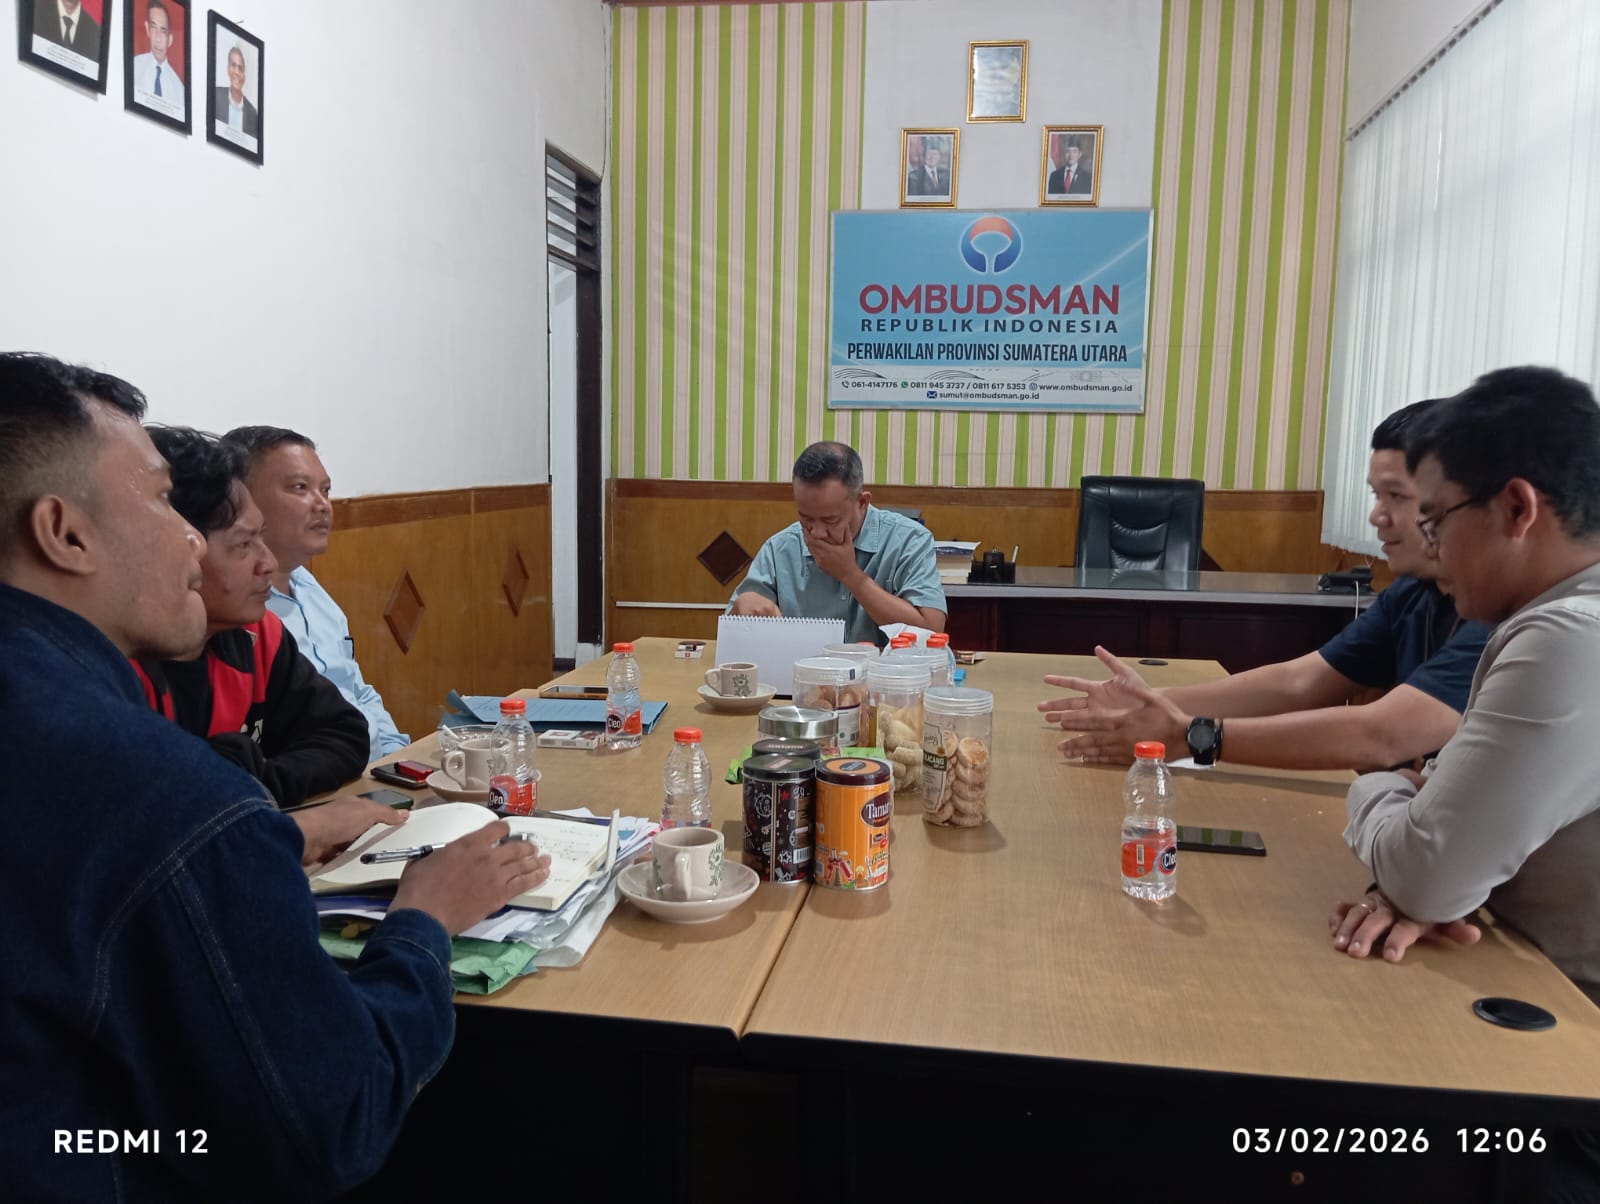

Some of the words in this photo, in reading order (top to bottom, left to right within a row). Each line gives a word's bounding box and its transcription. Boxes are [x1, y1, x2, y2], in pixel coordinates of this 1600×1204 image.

[859, 284, 1120, 315] OMBUDSMAN
[861, 318, 973, 333] REPUBLIK
[984, 319, 1118, 334] INDONESIA
[847, 342, 934, 360] PERWAKILAN
[937, 343, 1000, 361] PROVINSI
[1003, 343, 1078, 362] SUMATERA
[1081, 344, 1128, 363] UTARA
[851, 381, 898, 389] 061-4147176
[910, 381, 928, 389] 0811
[929, 381, 945, 389] 945
[946, 382, 965, 390] 3737
[972, 382, 990, 390] 0811
[991, 382, 1004, 390] 617
[1006, 383, 1026, 391] 5353
[1039, 383, 1133, 393] www.ombudsman.go.id
[939, 390, 1040, 400] sumut@ombudsman.go.id
